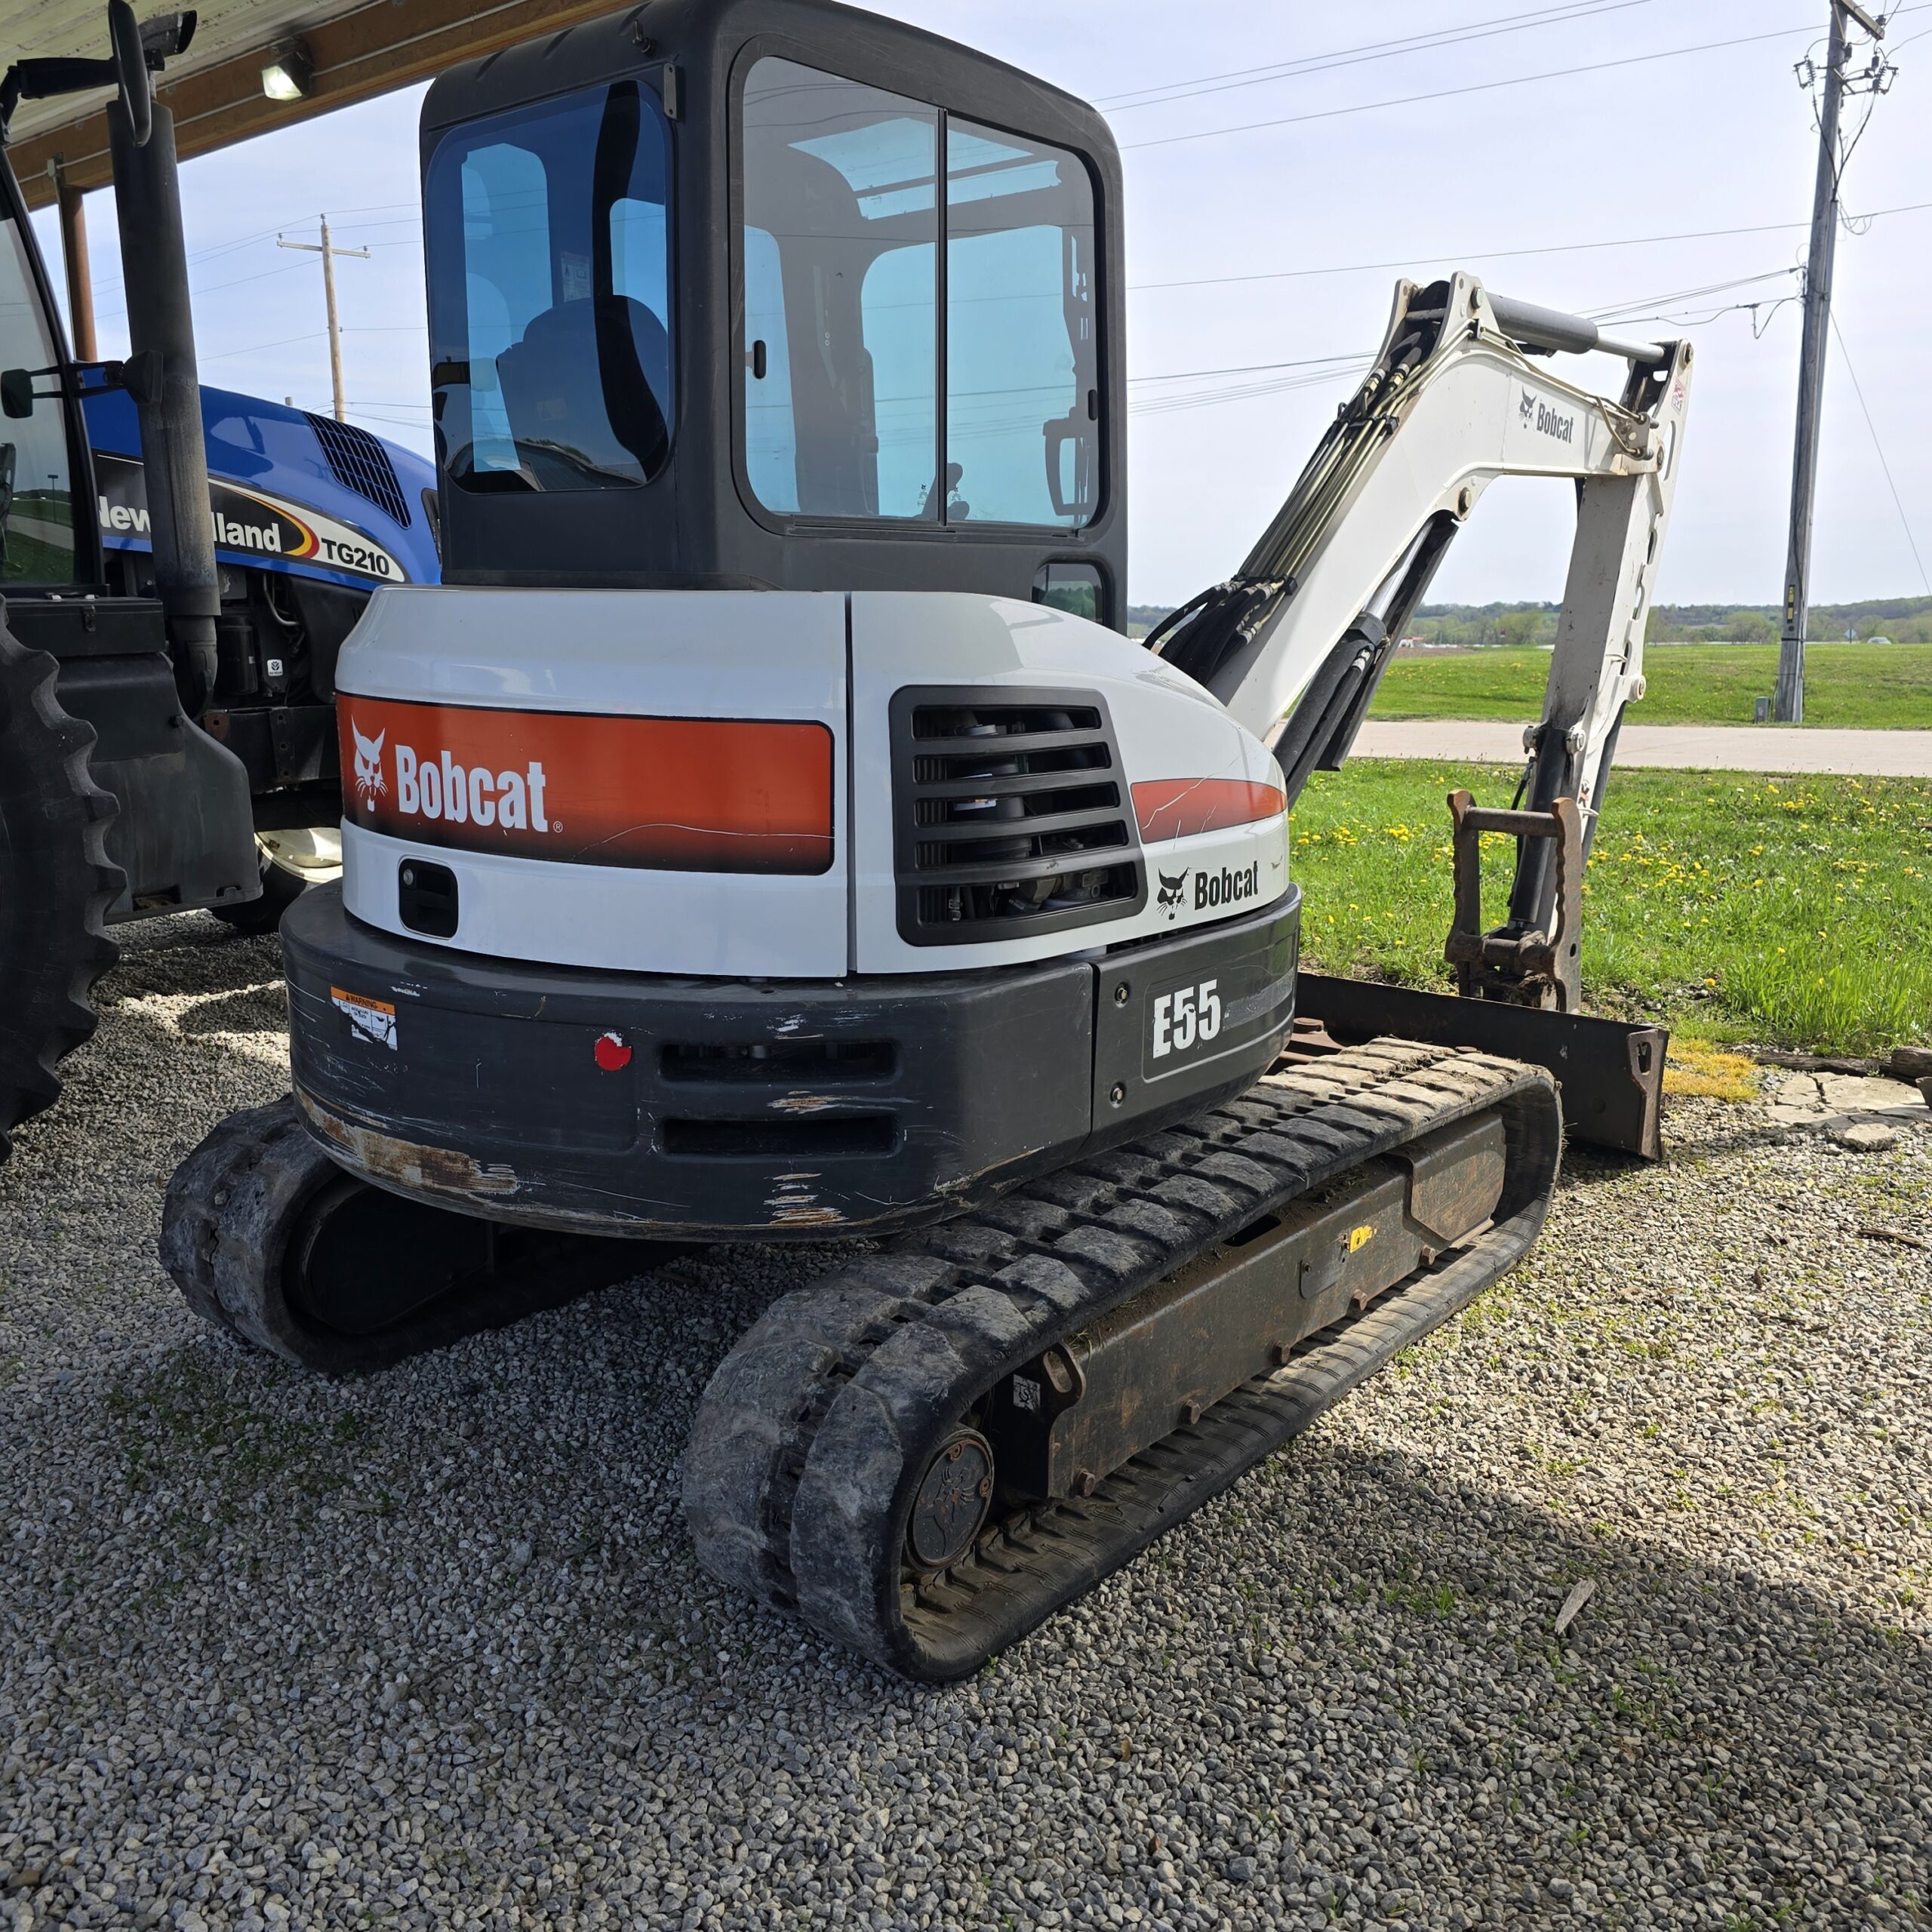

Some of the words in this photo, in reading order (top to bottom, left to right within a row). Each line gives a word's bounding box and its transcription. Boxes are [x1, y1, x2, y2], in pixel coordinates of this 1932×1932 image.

[1537, 402, 1574, 444] Bobcat
[211, 511, 281, 552] lland
[321, 538, 390, 576] TG210
[395, 744, 548, 832] Bobcat
[1195, 860, 1258, 910] Bobcat
[349, 995, 378, 1009] WARNING
[1152, 979, 1221, 1059] E55
